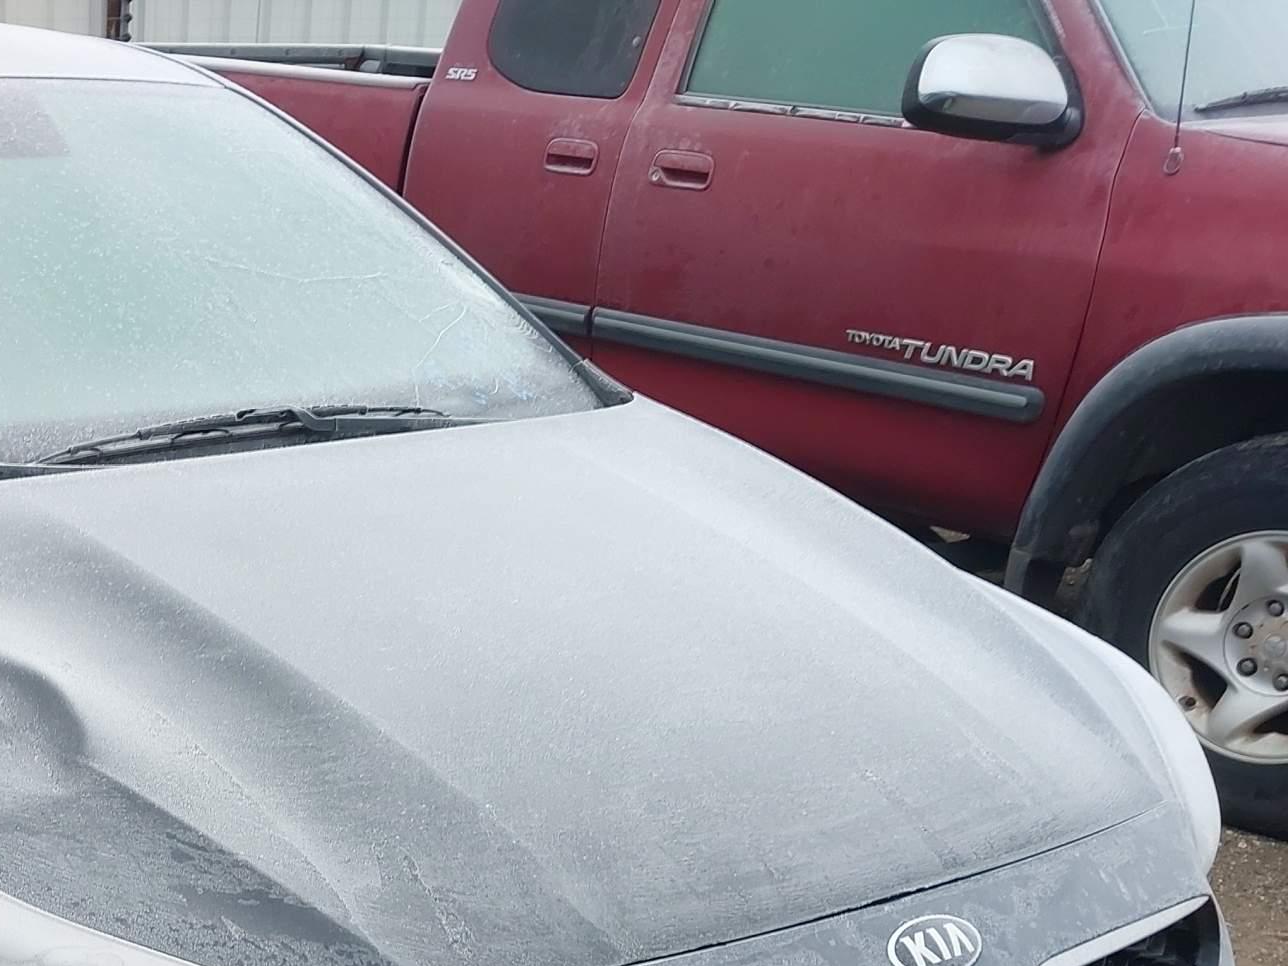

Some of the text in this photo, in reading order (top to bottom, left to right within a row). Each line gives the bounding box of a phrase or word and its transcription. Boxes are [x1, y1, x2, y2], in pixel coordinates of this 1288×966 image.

[445, 67, 478, 81] SR5
[846, 329, 1035, 382] TOYOTA TUNDRA
